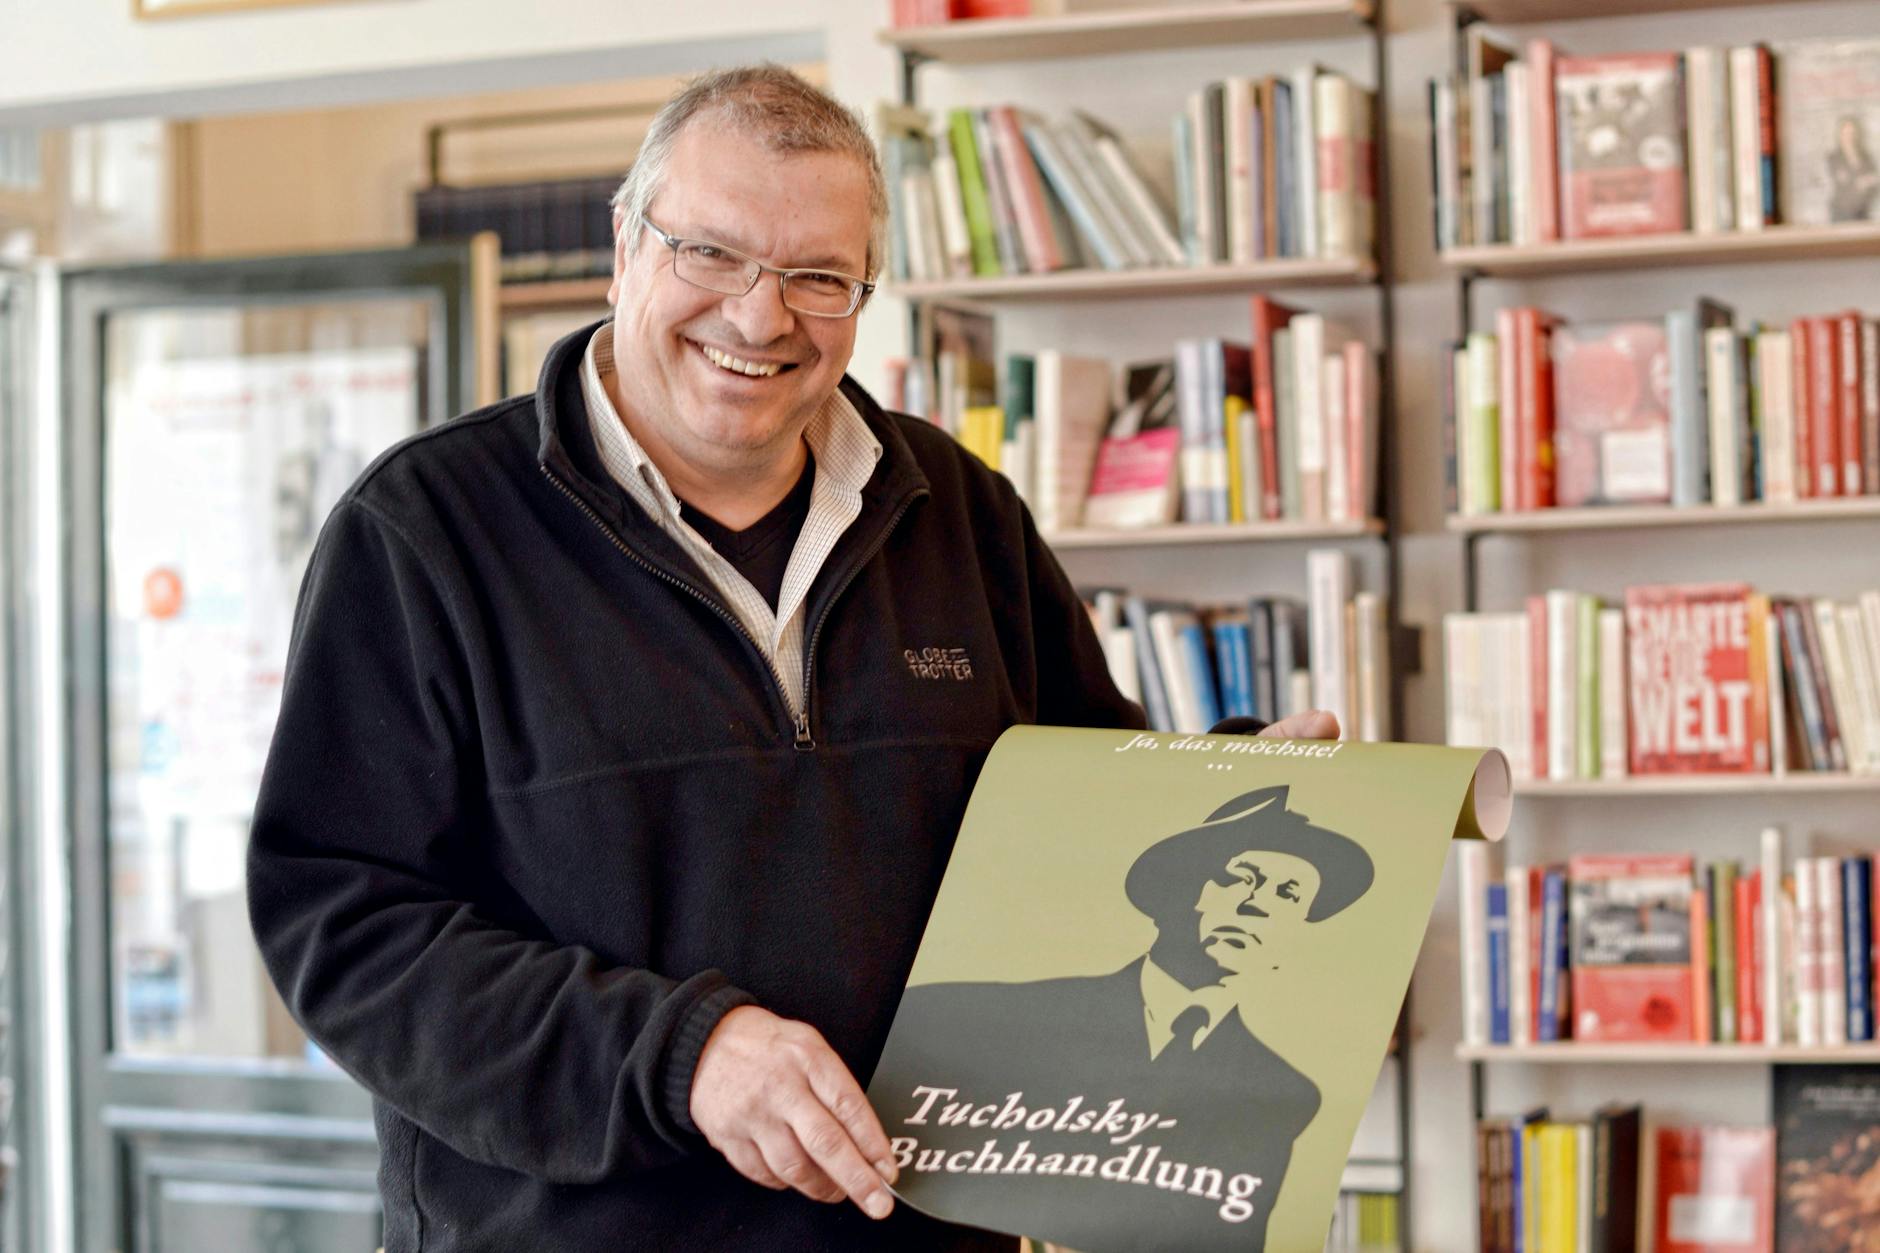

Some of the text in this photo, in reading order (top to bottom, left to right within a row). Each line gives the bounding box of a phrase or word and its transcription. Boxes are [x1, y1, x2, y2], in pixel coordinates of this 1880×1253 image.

[904, 647, 952, 664] GLOBE
[909, 663, 974, 680] TROTTER
[1630, 681, 1751, 754] WELT
[1115, 733, 1343, 758] Ja, das möchste!
[904, 1085, 1177, 1144] Tucholsky-
[890, 1137, 1262, 1222] Buchhandlung
